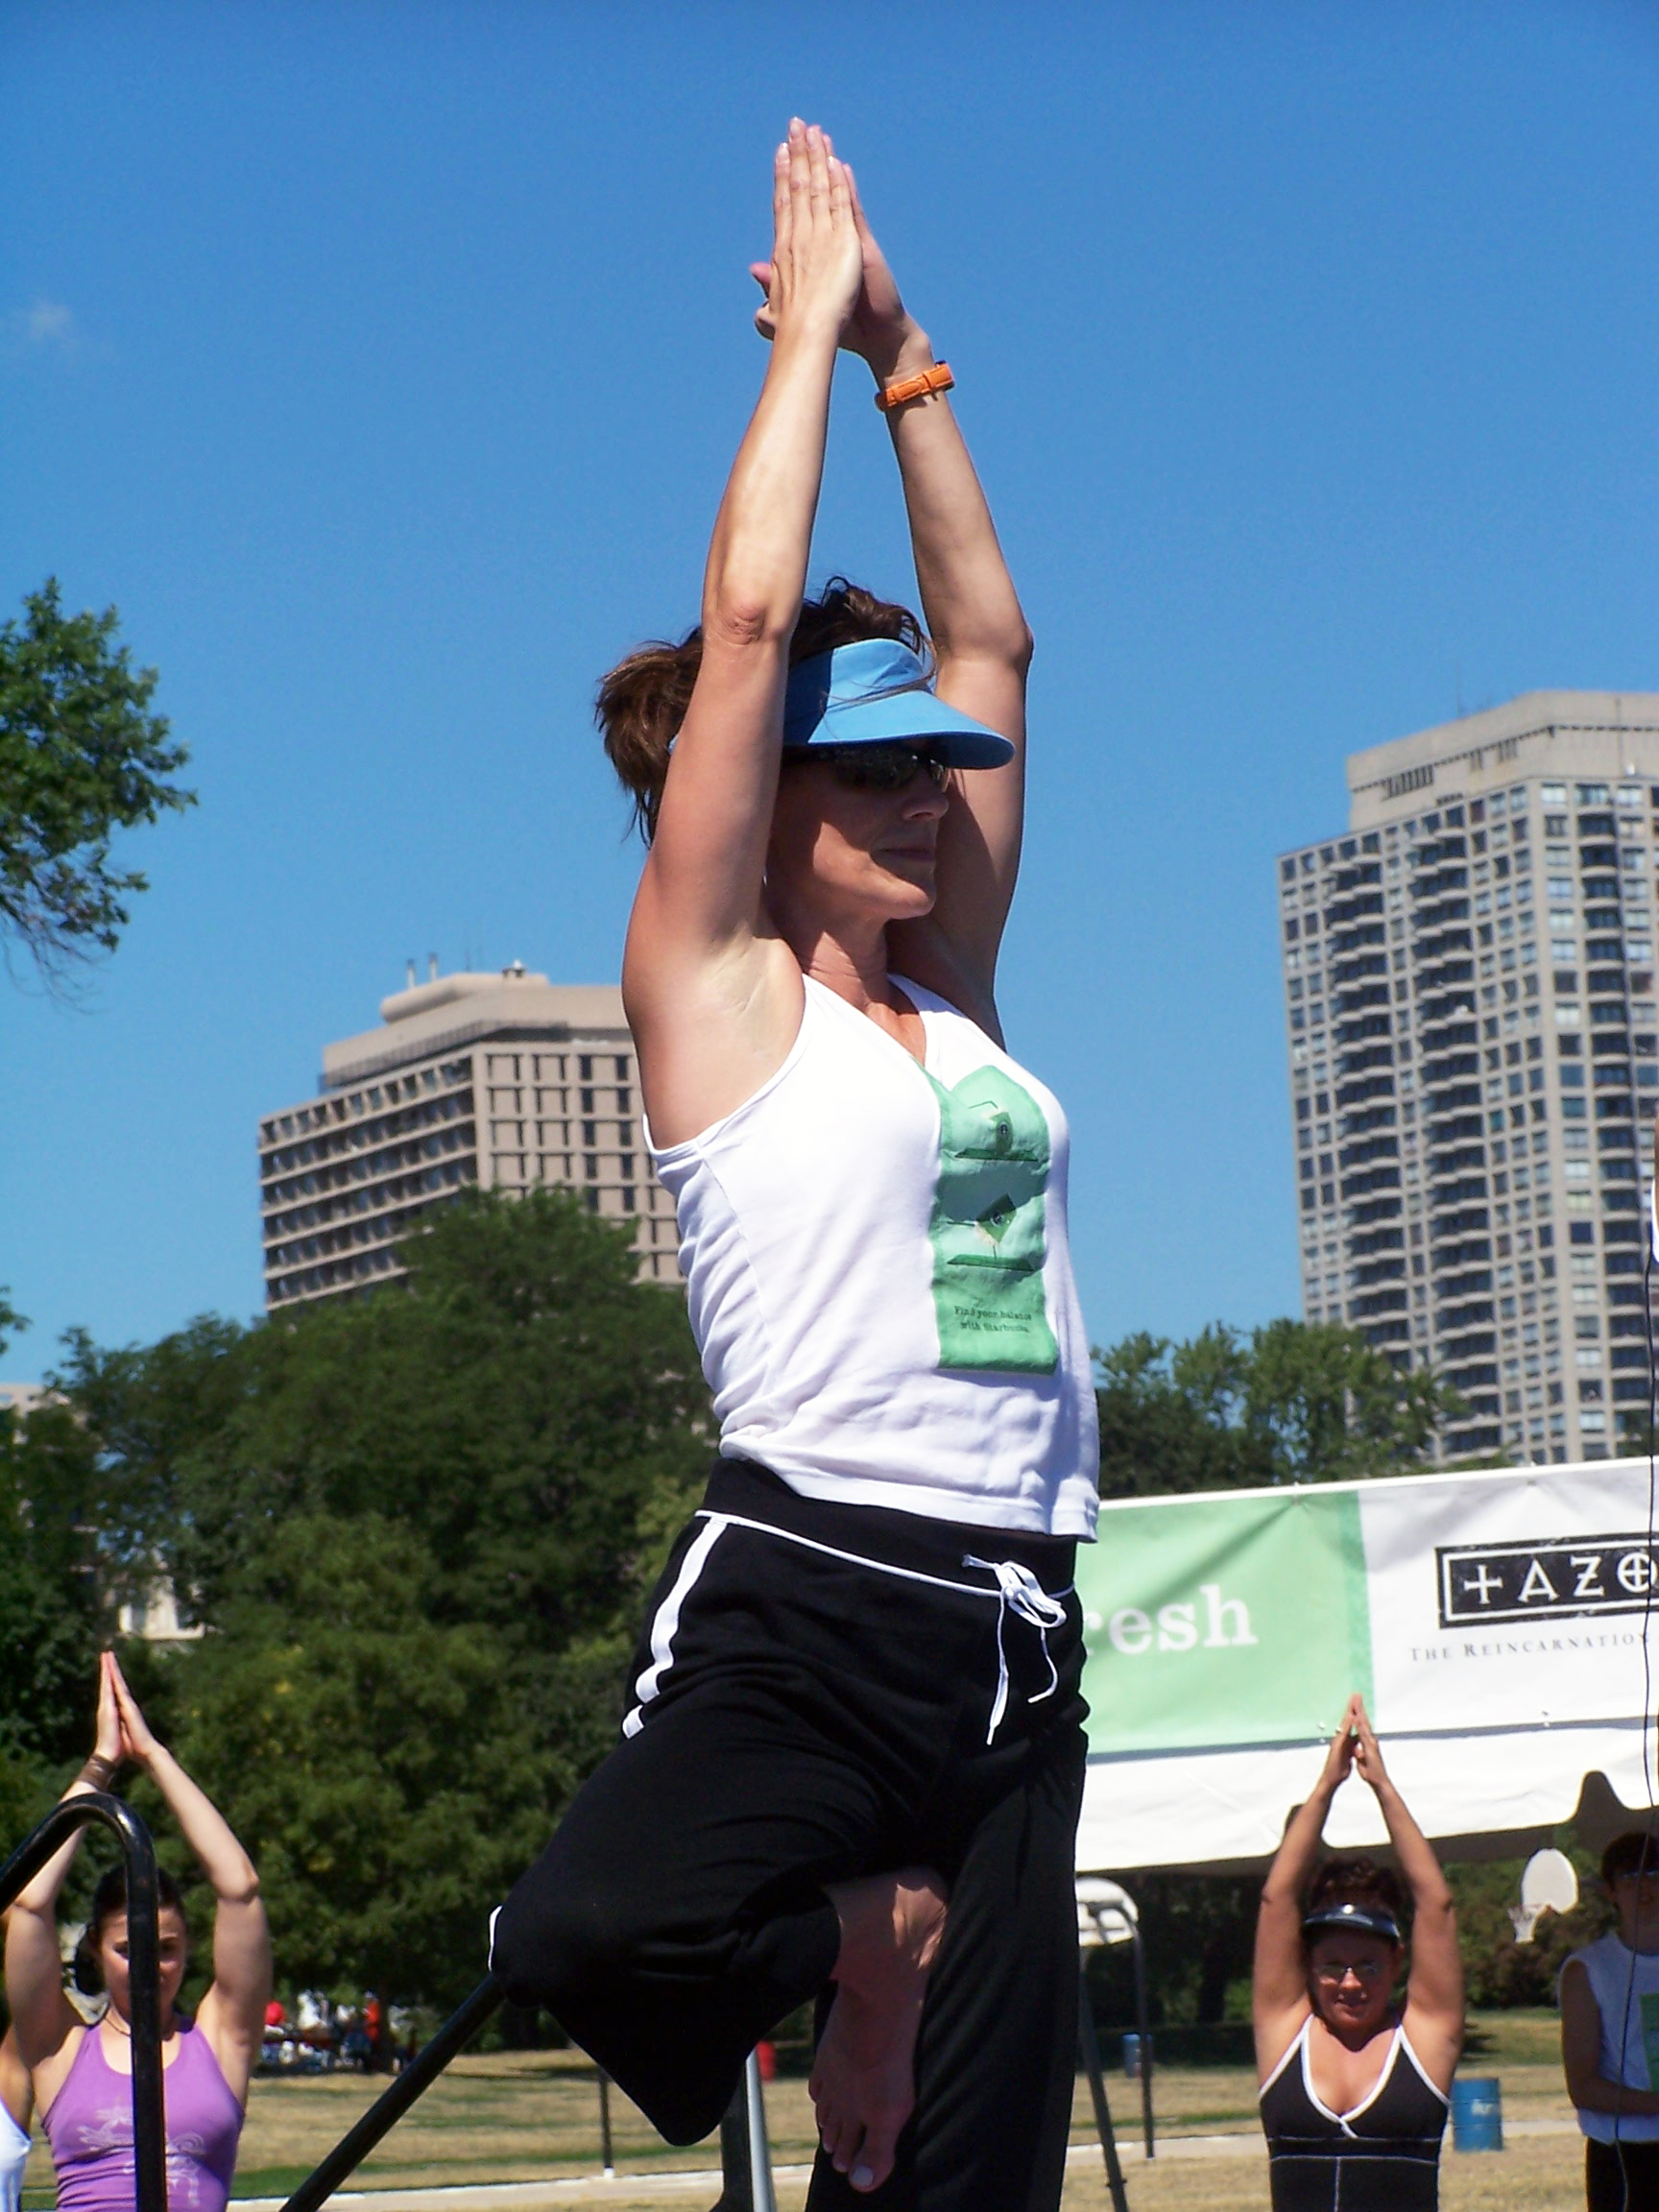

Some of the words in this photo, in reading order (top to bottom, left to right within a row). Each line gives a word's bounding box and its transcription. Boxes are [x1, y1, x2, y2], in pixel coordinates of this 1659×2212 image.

[954, 1306, 975, 1316] Find
[976, 1310, 998, 1319] your
[960, 1321, 980, 1331] with
[1410, 1647, 1454, 1661] THE
